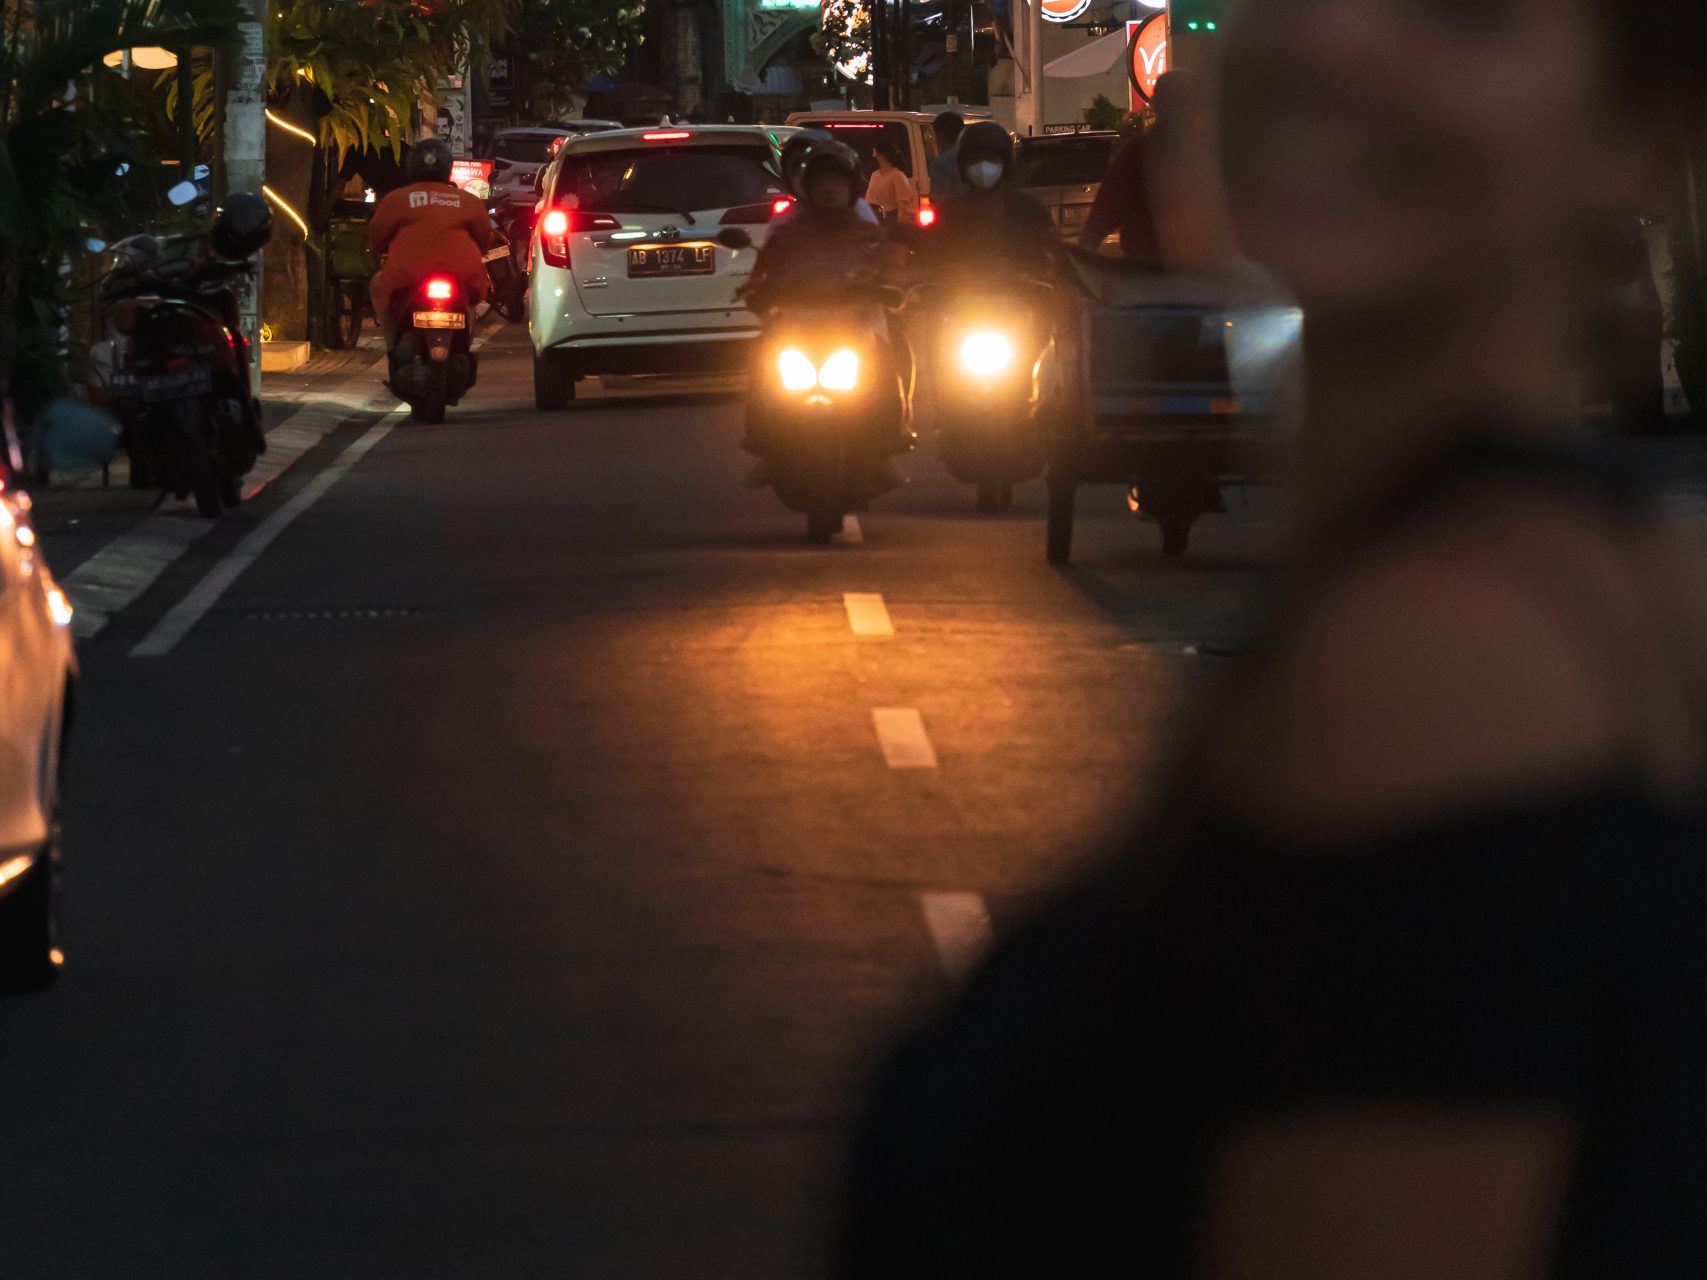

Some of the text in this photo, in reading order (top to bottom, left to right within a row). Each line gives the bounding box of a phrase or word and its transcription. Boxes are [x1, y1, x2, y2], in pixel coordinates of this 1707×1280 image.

[1045, 125, 1075, 134] PARKING
[430, 198, 460, 208] Food
[632, 251, 647, 265] AB
[696, 247, 710, 262] LF
